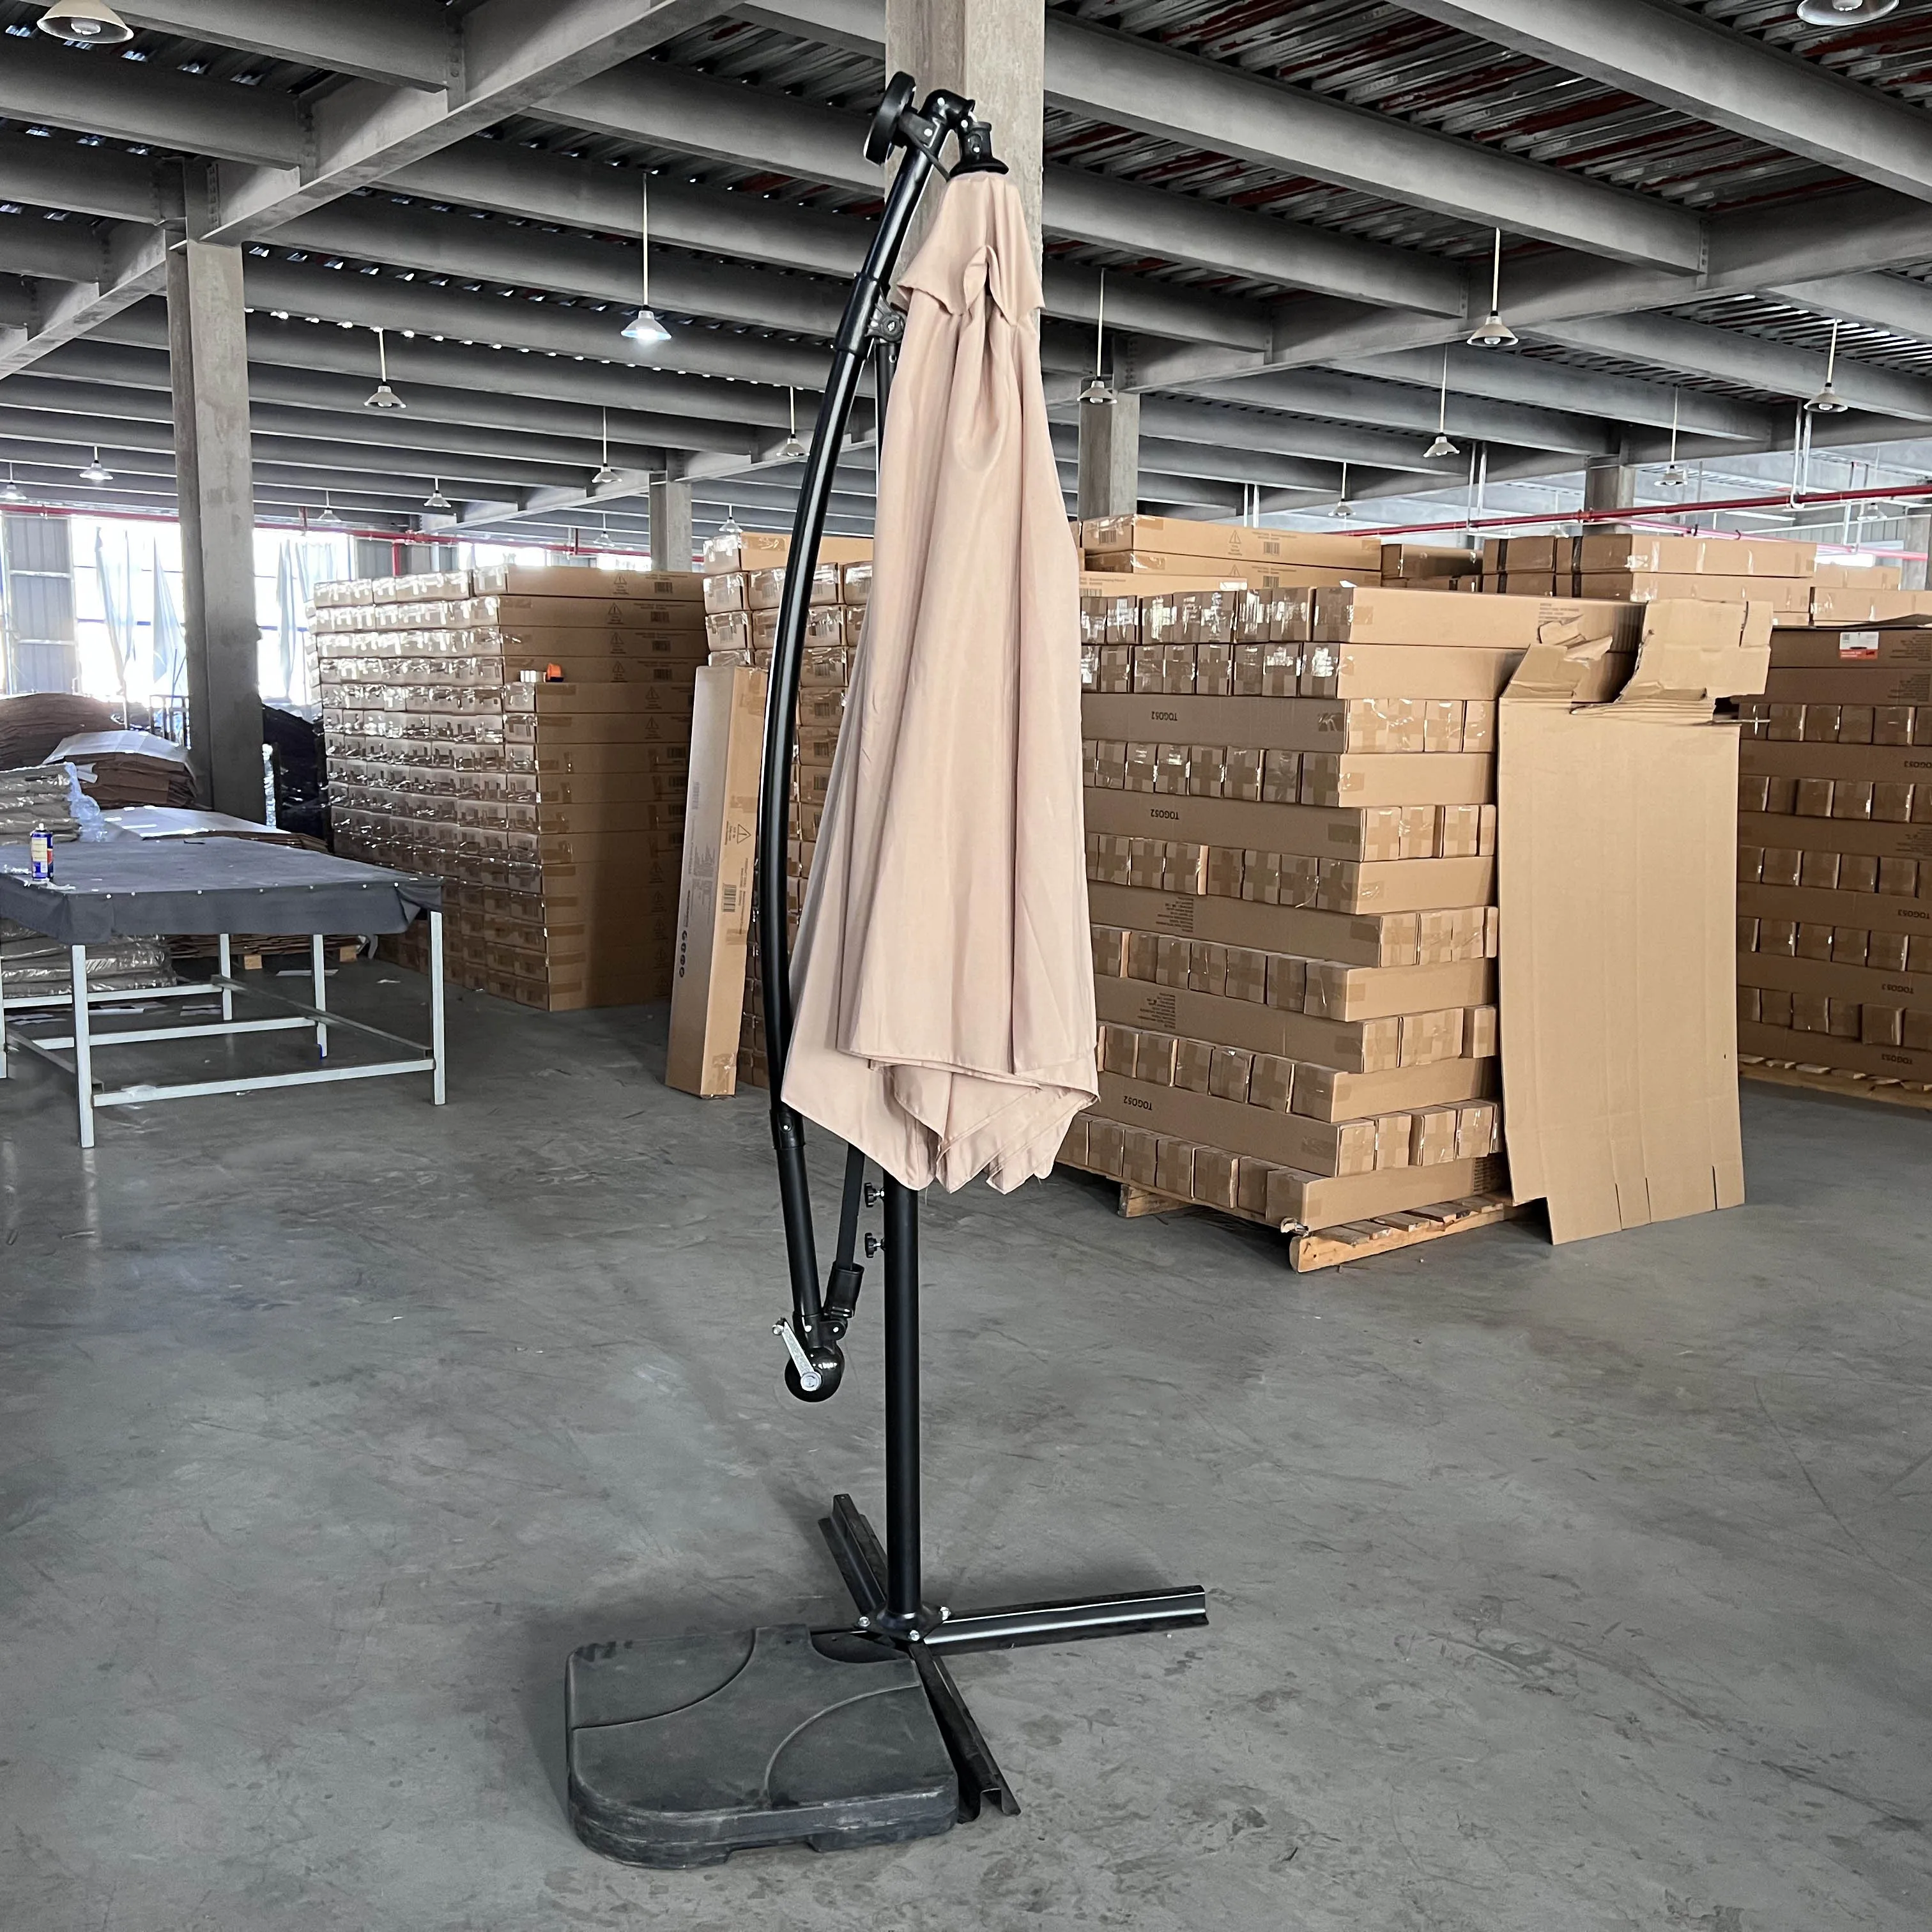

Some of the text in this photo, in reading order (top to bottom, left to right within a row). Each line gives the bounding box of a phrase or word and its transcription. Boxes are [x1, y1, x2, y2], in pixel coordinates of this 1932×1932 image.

[1151, 711, 1177, 721] TOGO52
[1151, 809, 1179, 820] TOGO52
[1123, 1096, 1153, 1110] TOGO52
